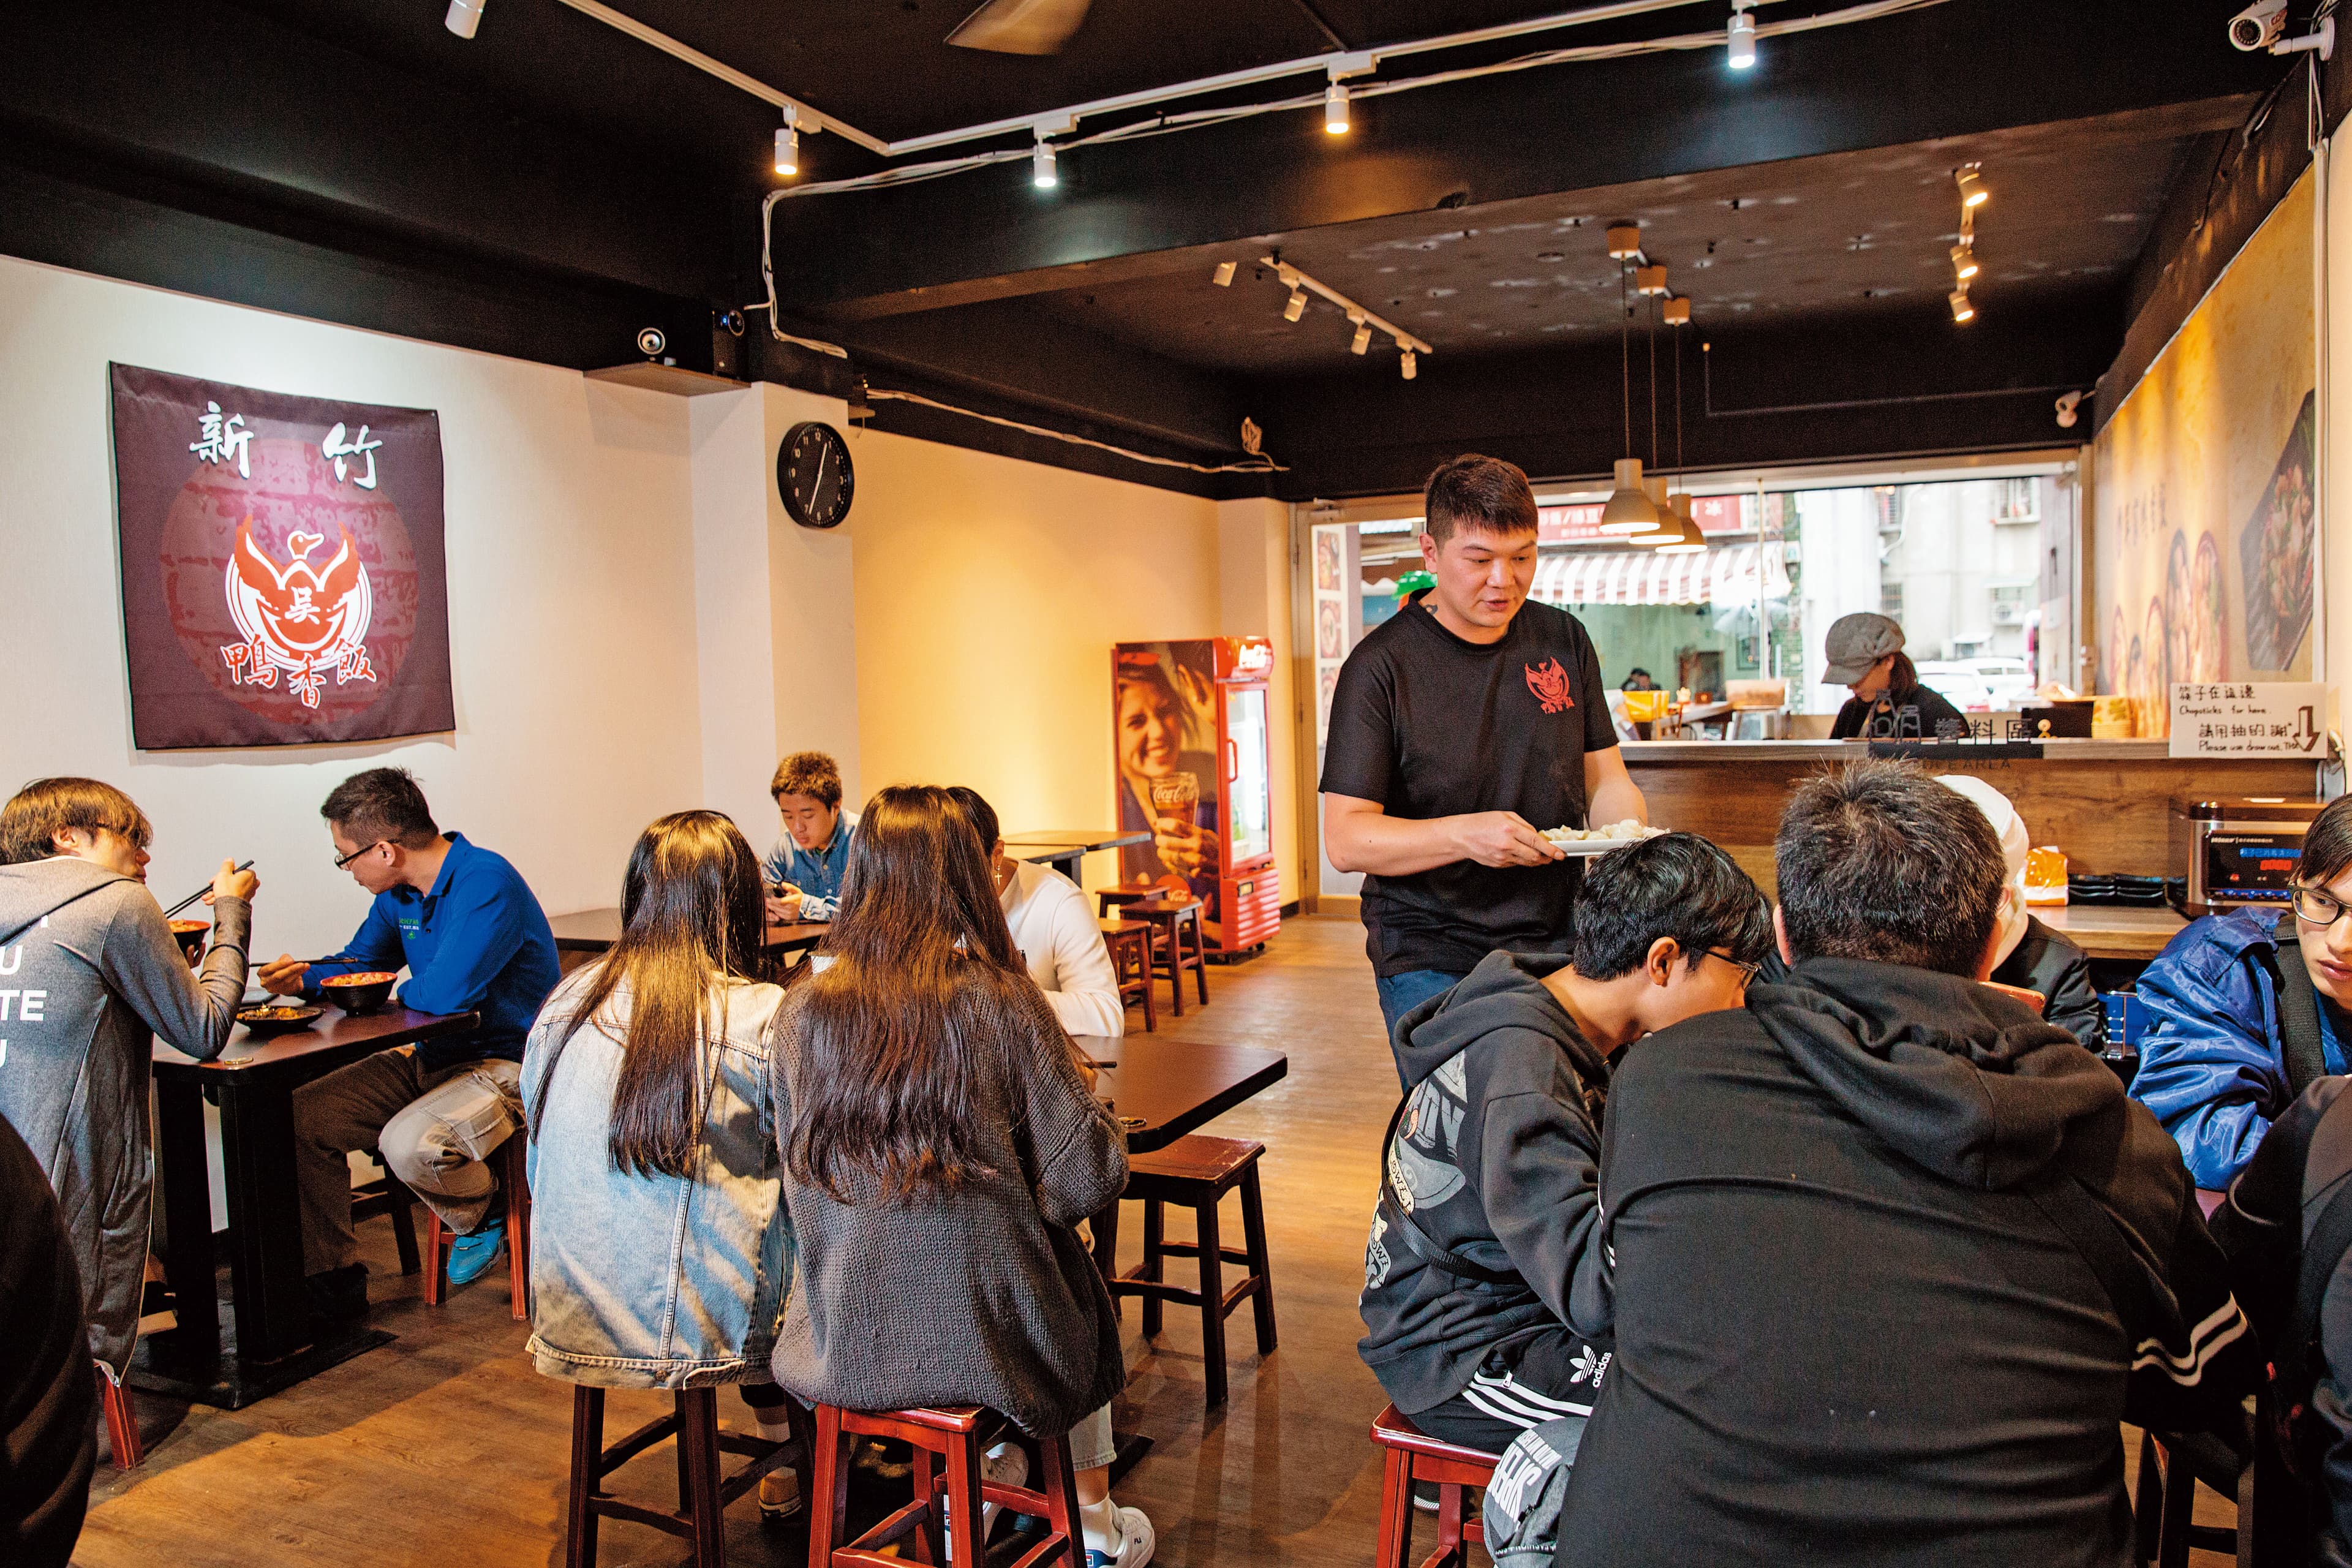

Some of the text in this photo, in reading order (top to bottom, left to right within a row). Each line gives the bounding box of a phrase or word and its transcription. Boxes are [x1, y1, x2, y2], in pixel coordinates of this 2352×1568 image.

[189, 401, 382, 489] 新竹
[285, 586, 321, 625] 吳
[221, 633, 377, 709] 鴨香飯
[1593, 1352, 1612, 1388] adidas
